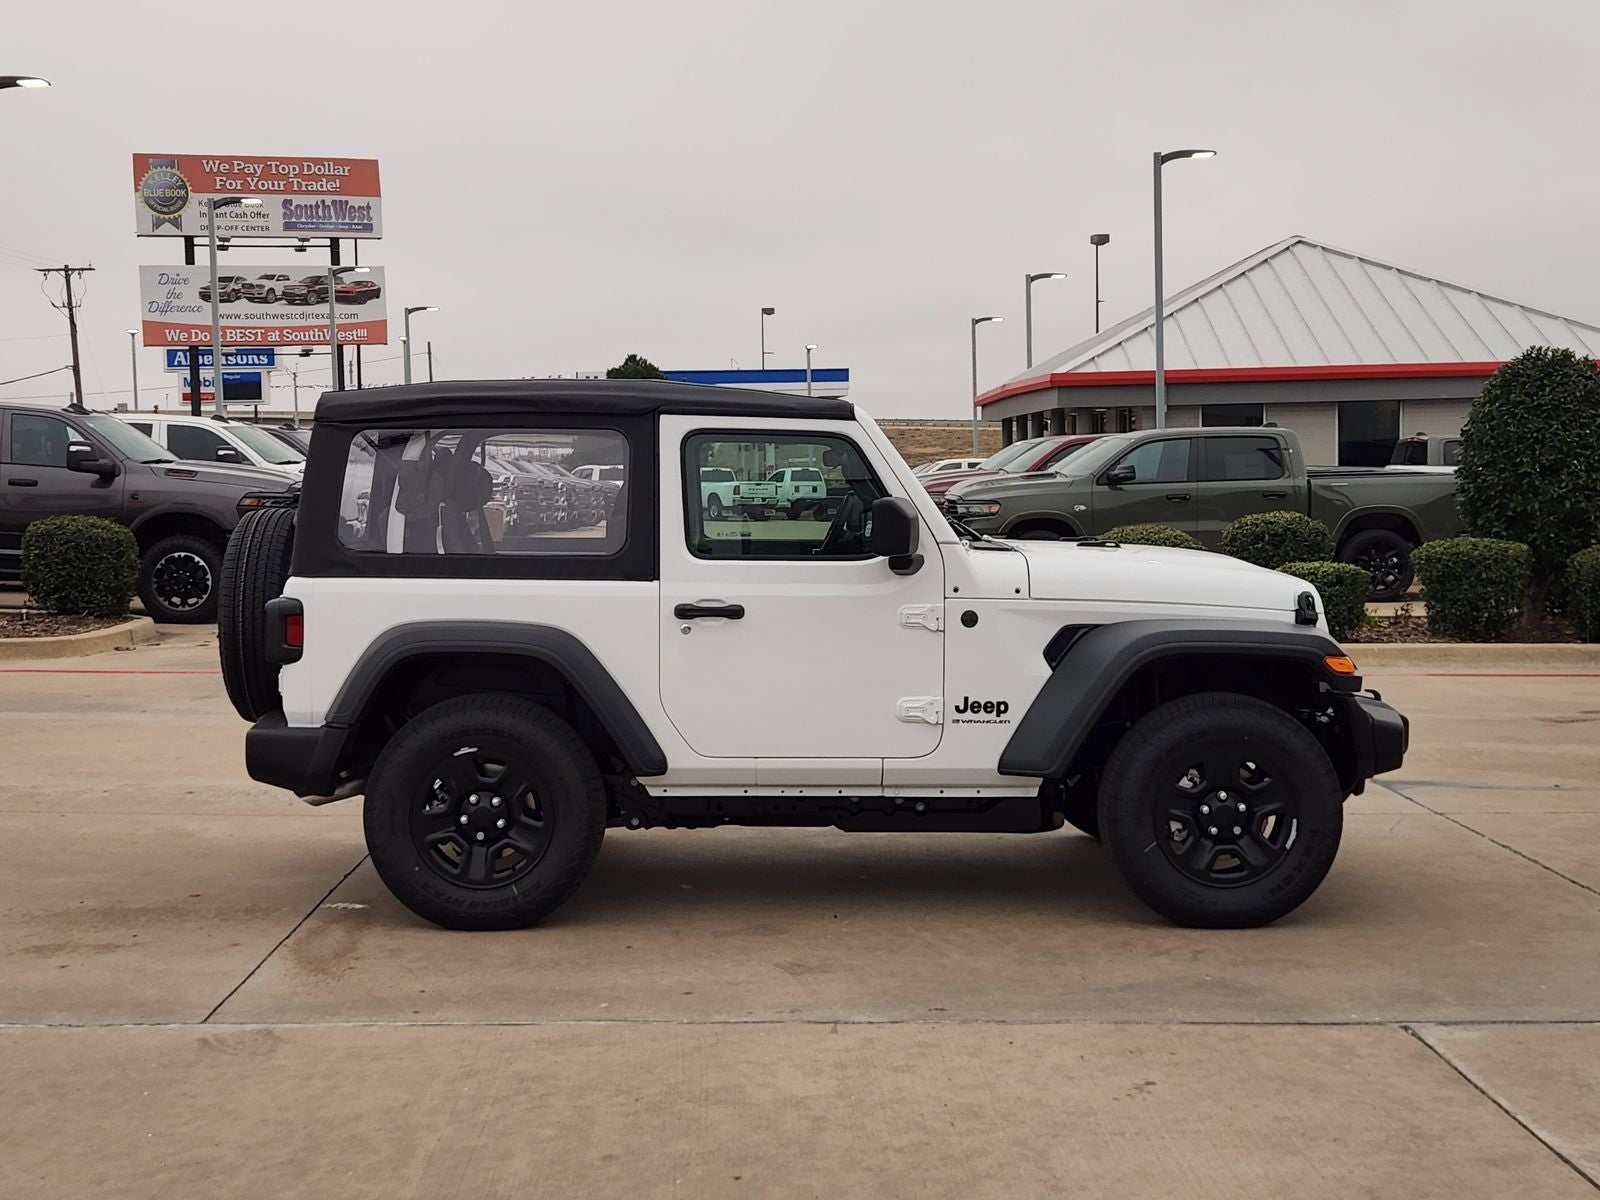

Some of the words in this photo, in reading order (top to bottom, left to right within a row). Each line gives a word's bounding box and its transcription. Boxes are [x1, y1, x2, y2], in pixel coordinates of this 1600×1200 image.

[201, 160, 230, 173] We
[232, 160, 264, 177] Pay
[267, 161, 299, 177] Top
[302, 161, 351, 176] Dollar
[149, 172, 184, 186] KELLEY
[214, 177, 243, 190] For
[246, 177, 287, 191] Your
[289, 178, 341, 192] Trade!
[143, 188, 164, 197] BLUE
[165, 188, 187, 197] BOOK
[229, 211, 248, 219] Cash
[249, 211, 270, 219] Offer
[281, 198, 373, 222] SouthWest
[158, 272, 190, 285] Drive
[166, 287, 183, 300] the
[148, 300, 203, 316] Difference
[218, 311, 359, 321] www.southwestcdjrtexa.com
[165, 329, 188, 342] We
[191, 329, 210, 342] Do
[225, 329, 265, 342] BEST
[267, 331, 280, 341] at
[954, 696, 1009, 718] Jeep
